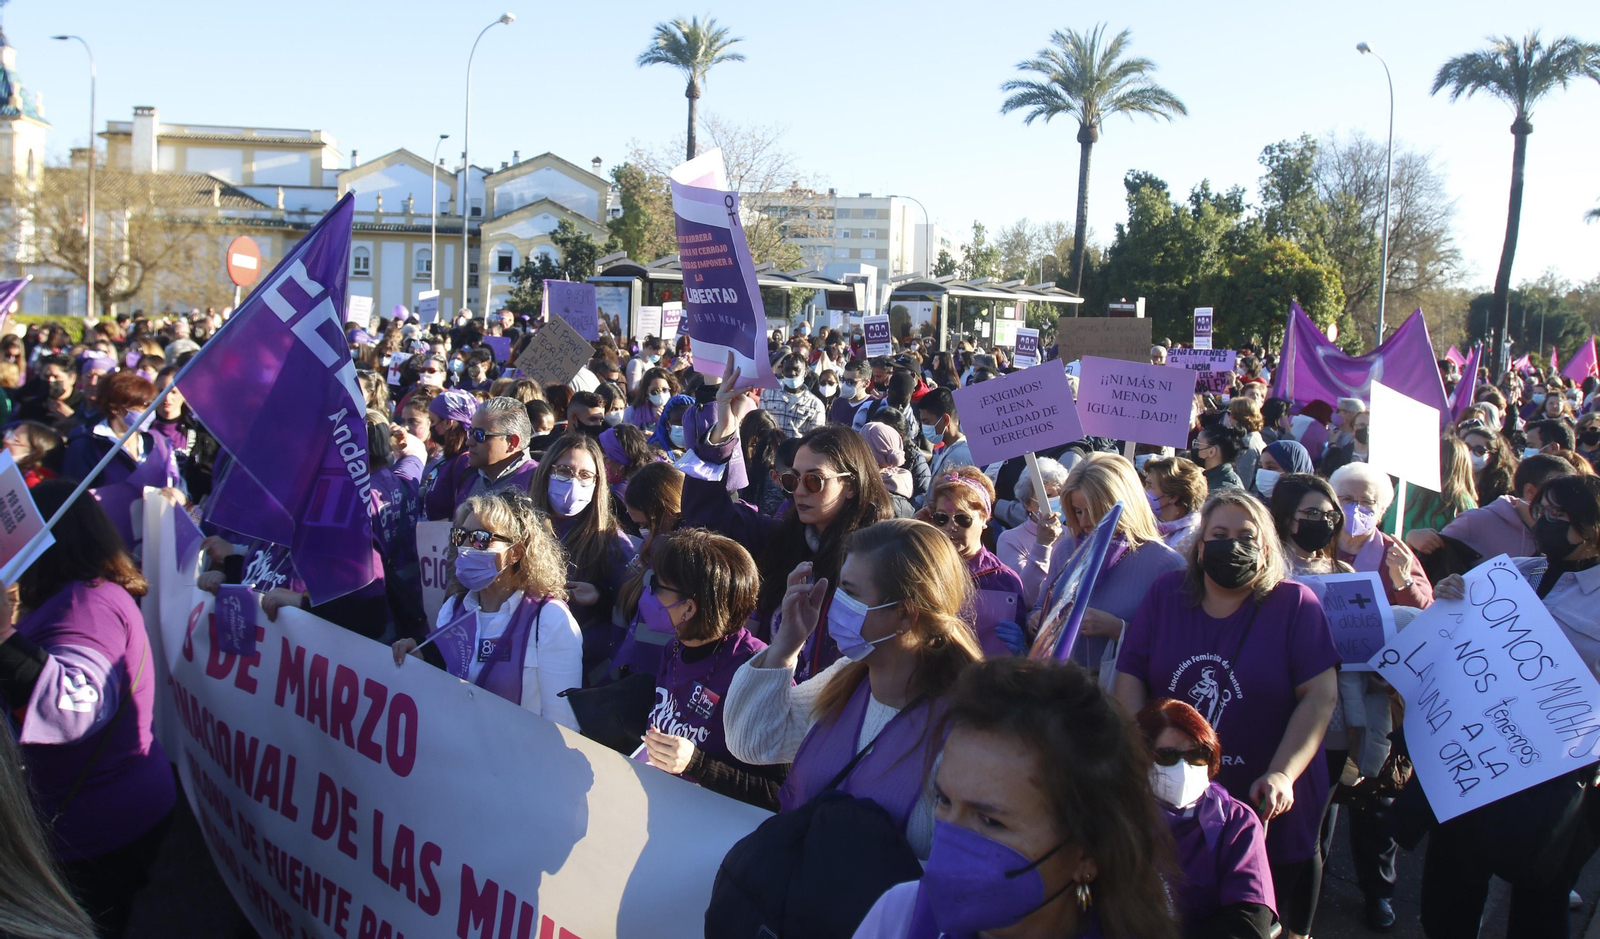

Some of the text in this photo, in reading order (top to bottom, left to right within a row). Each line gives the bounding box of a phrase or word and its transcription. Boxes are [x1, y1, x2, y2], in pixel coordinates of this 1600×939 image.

[698, 244, 728, 256] CERROJO
[697, 257, 727, 268] IMPONER
[728, 257, 733, 265] A
[694, 273, 704, 282] LA
[685, 287, 738, 304] LIBERTAD
[693, 312, 746, 332] DE MI MENTE
[548, 319, 583, 356] EL PORNO
[530, 345, 539, 354] LA
[1188, 349, 1228, 357] ENTIENDES
[531, 355, 540, 365] ES
[571, 356, 580, 366] LA
[1185, 363, 1211, 371] LUCHA
[1126, 373, 1156, 390] MÁS
[1158, 379, 1173, 392] NI
[979, 380, 1043, 410] ¡EXIGIMOS!
[1111, 389, 1158, 405] MENOS
[995, 398, 1034, 416] PLENA
[979, 404, 1059, 436] IGUALDAD DE
[991, 421, 1055, 446] DERECHOS
[5, 488, 27, 524] POR SER
[1339, 612, 1381, 629] dobles
[1469, 567, 1600, 759] SOMOS MUCHAS
[1168, 659, 1193, 692] Asociación
[1221, 659, 1230, 670] de
[182, 601, 205, 663] 8
[274, 636, 419, 777] MARZO
[1454, 640, 1498, 693] NOS
[1484, 697, 1540, 765] tenemos
[1461, 723, 1509, 779] A LA
[1439, 740, 1480, 795] OTRA
[311, 772, 358, 860] DE
[372, 808, 442, 917] LAS
[237, 810, 262, 865] DE
[262, 837, 352, 939] FUENTE
